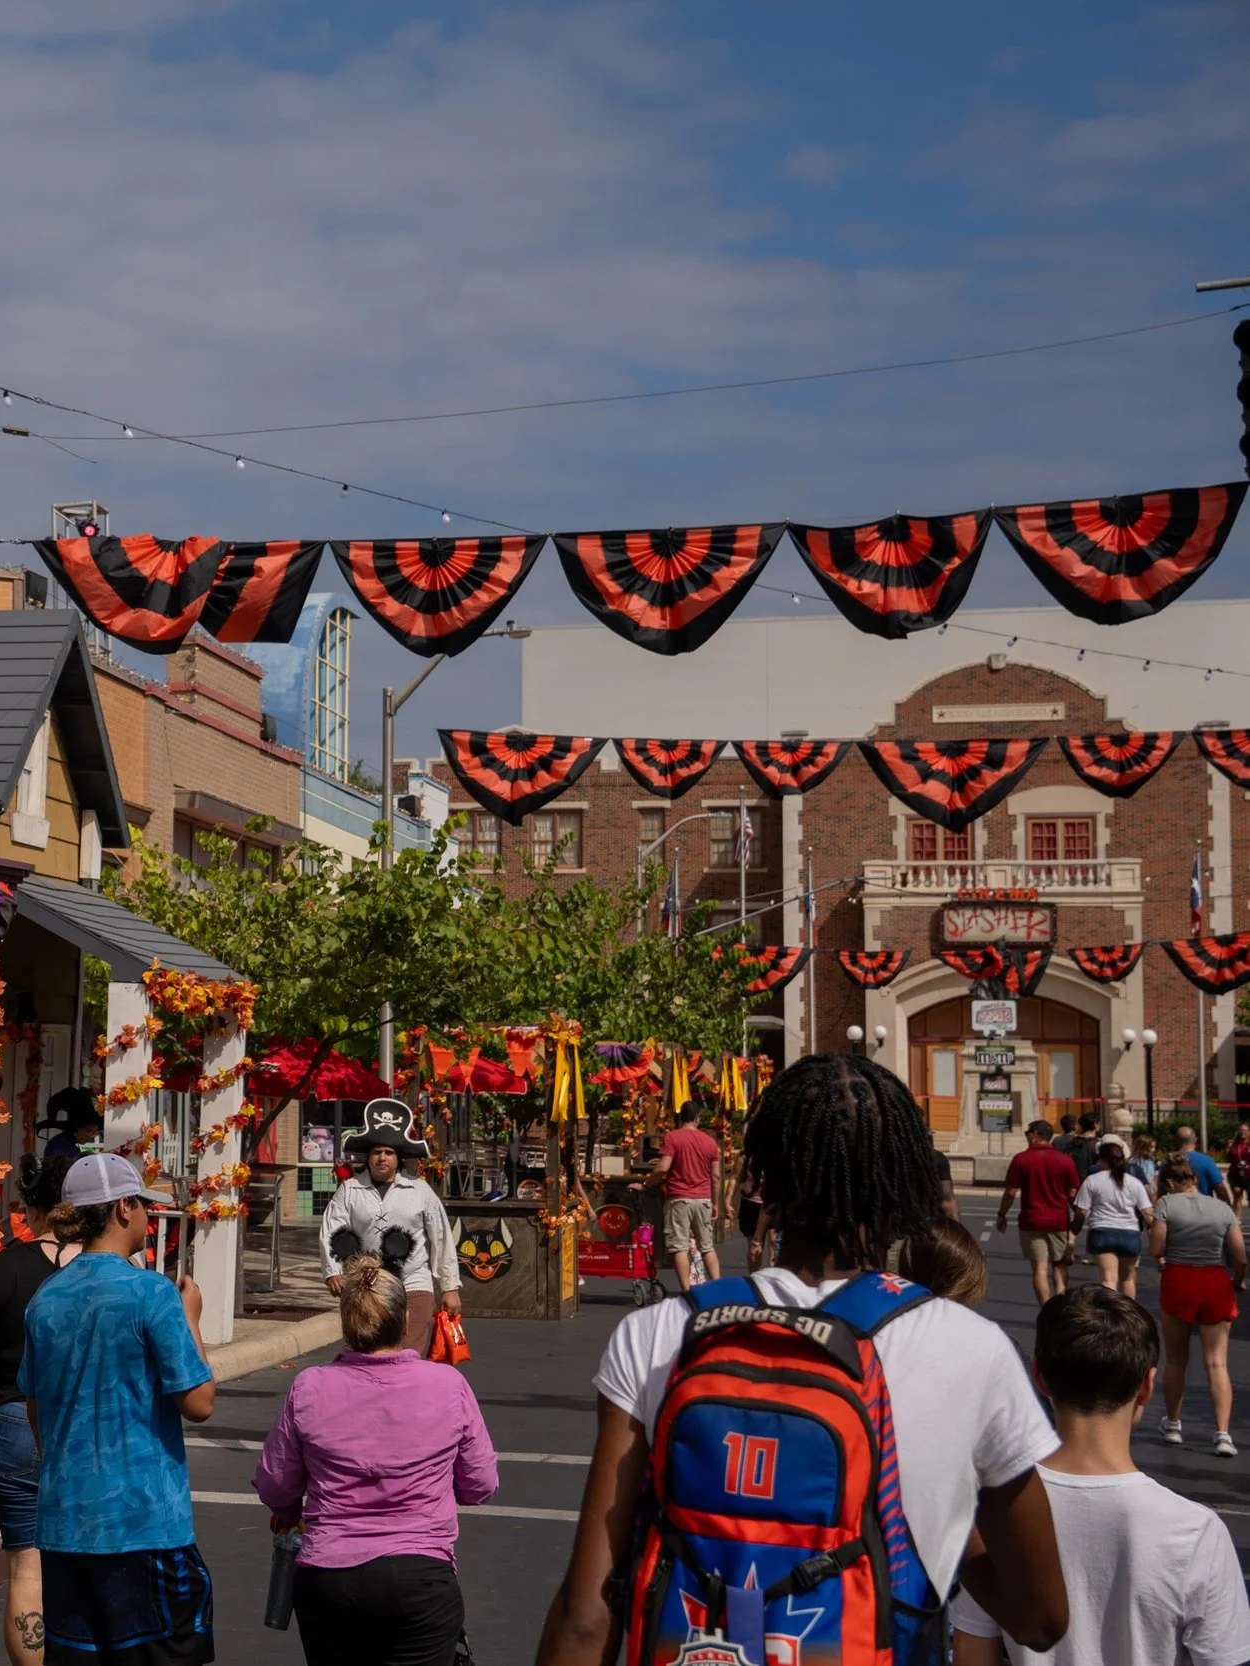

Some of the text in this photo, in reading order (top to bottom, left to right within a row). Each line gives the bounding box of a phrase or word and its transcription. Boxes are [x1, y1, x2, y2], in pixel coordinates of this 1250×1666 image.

[958, 886, 1039, 901] CINEMA
[946, 906, 1050, 941] SLASHER
[693, 1304, 834, 1343] DC SPORTS
[722, 1431, 779, 1500] 10
